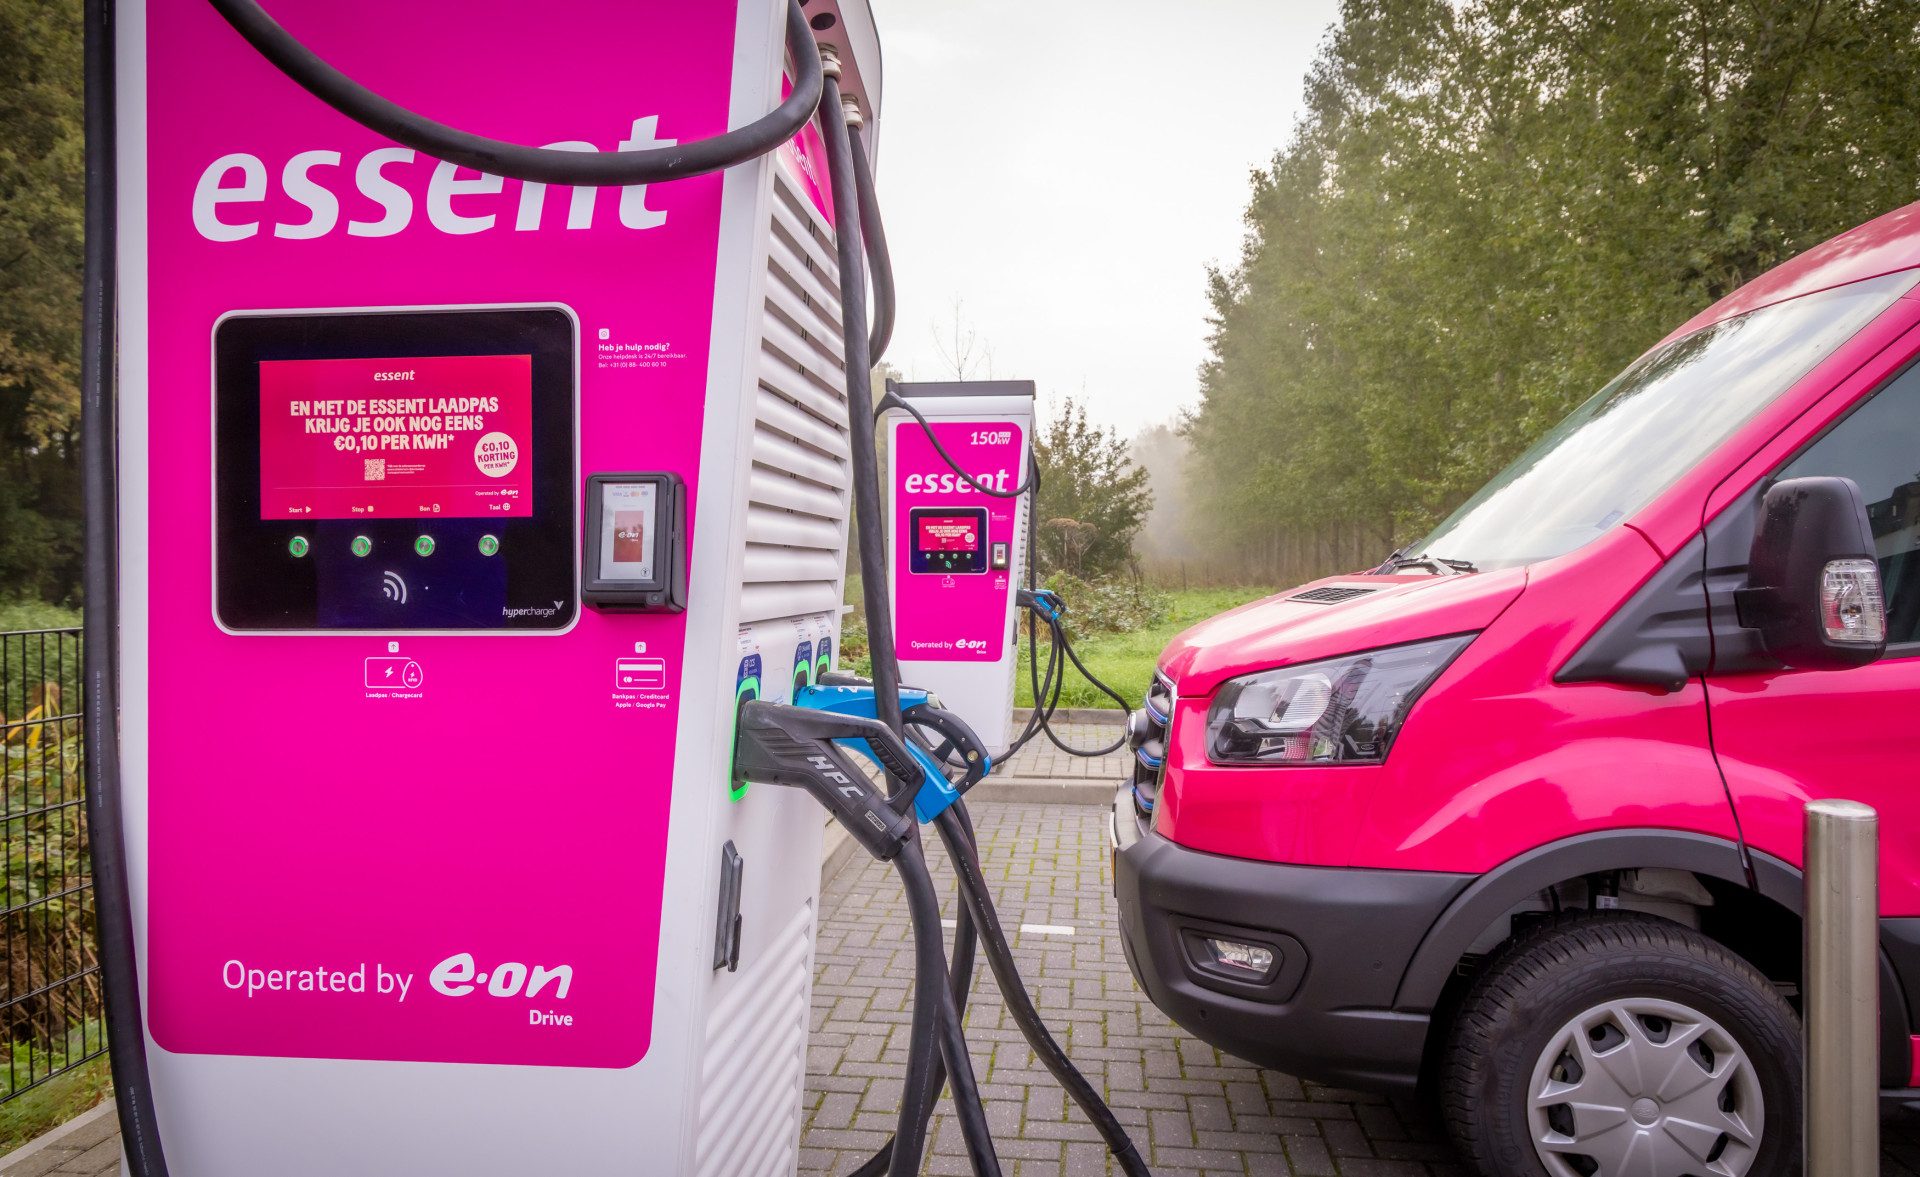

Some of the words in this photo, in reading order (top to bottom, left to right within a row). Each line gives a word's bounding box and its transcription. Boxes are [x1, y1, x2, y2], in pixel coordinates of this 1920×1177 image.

[192, 114, 678, 242] essent
[616, 343, 623, 352] je
[625, 343, 642, 352] hulp
[644, 342, 670, 351] nodig?
[374, 370, 415, 381] essent
[290, 401, 310, 416] EN
[313, 400, 344, 415] MET
[346, 400, 366, 415] DE
[369, 398, 426, 415] ESSENT
[428, 396, 499, 413] LAADPAS
[305, 418, 350, 434] KRIJG
[352, 417, 371, 432] JE
[373, 416, 406, 432] OOK
[409, 416, 442, 432] NOG
[445, 415, 484, 431] EENS
[333, 435, 378, 453] €0,10
[380, 434, 410, 450] PER
[482, 441, 509, 452] €0,10
[970, 431, 998, 445] 150
[477, 452, 515, 463] KORTING
[905, 469, 1009, 493] essent
[503, 607, 556, 617] hypercharger
[911, 641, 942, 649] Operated
[944, 641, 952, 649] by
[807, 756, 864, 798] HPC
[223, 960, 365, 997] Operated
[377, 964, 413, 1002] by
[529, 1009, 573, 1026] Drive
